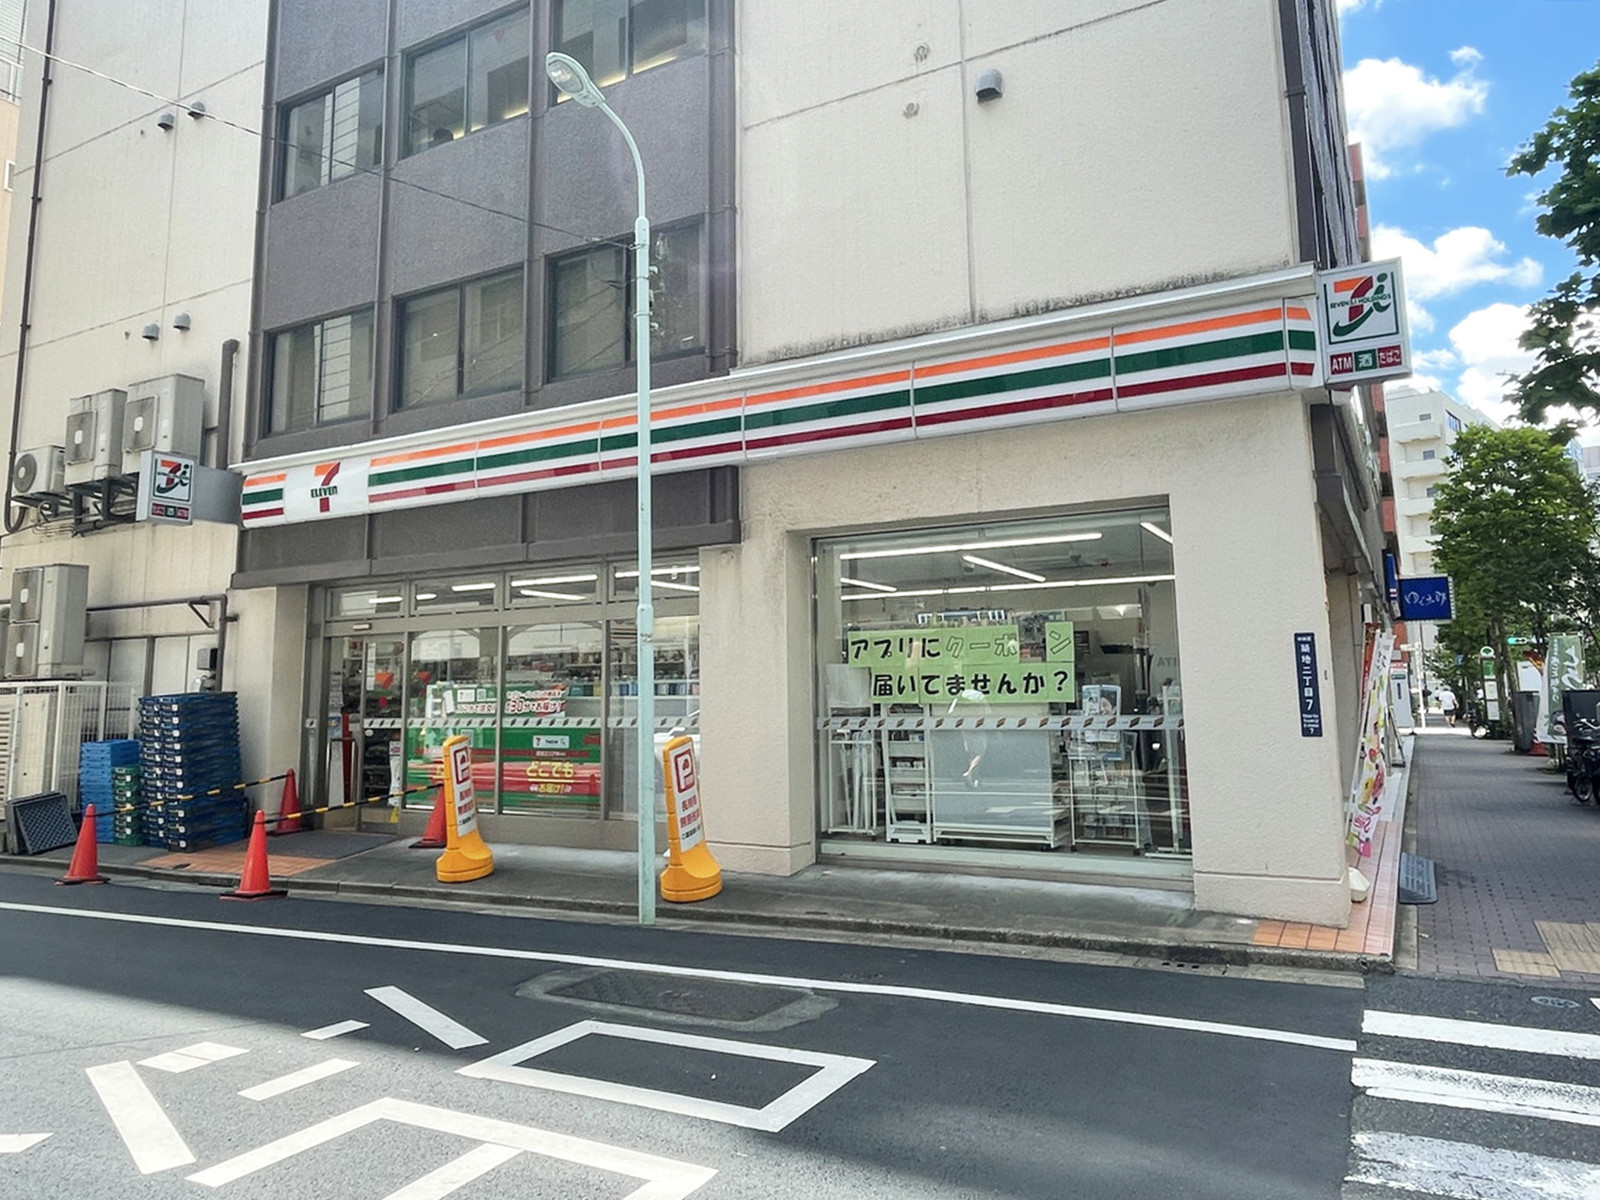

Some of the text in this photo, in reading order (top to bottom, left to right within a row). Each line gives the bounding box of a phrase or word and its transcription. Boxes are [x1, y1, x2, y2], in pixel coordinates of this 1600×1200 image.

[1332, 350, 1400, 371] ATM 酒 たばこ
[851, 630, 1072, 660] アプリにクーポン
[873, 670, 1068, 697] 届いてませんか？
[526, 761, 574, 778] どこでも
